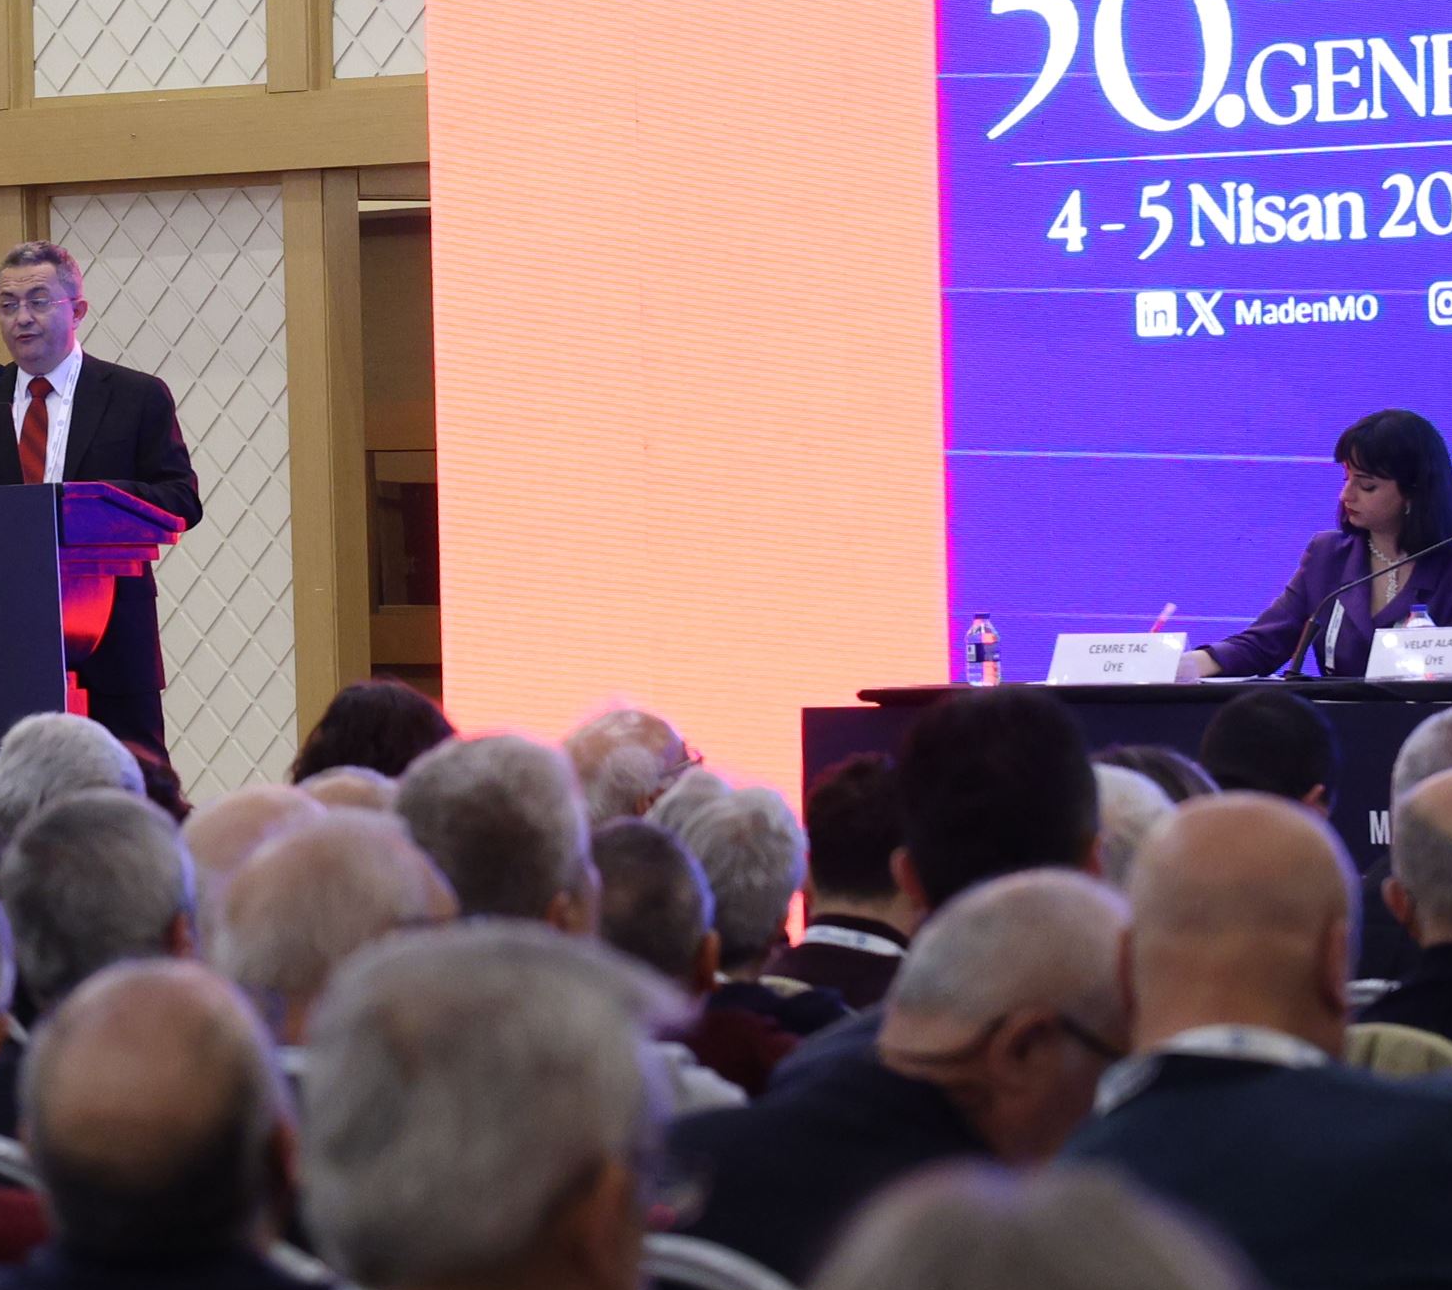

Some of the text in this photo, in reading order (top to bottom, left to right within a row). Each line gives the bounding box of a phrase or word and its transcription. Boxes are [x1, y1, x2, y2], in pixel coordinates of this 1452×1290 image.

[1047, 190, 1087, 252] 4
[1138, 181, 1172, 259] 5
[1189, 182, 1367, 246] Nisan
[1236, 295, 1378, 324] MadenMO
[1089, 644, 1124, 654] CEMRE
[1103, 661, 1124, 672] ÜYE
[1425, 656, 1445, 666] ÜYE
